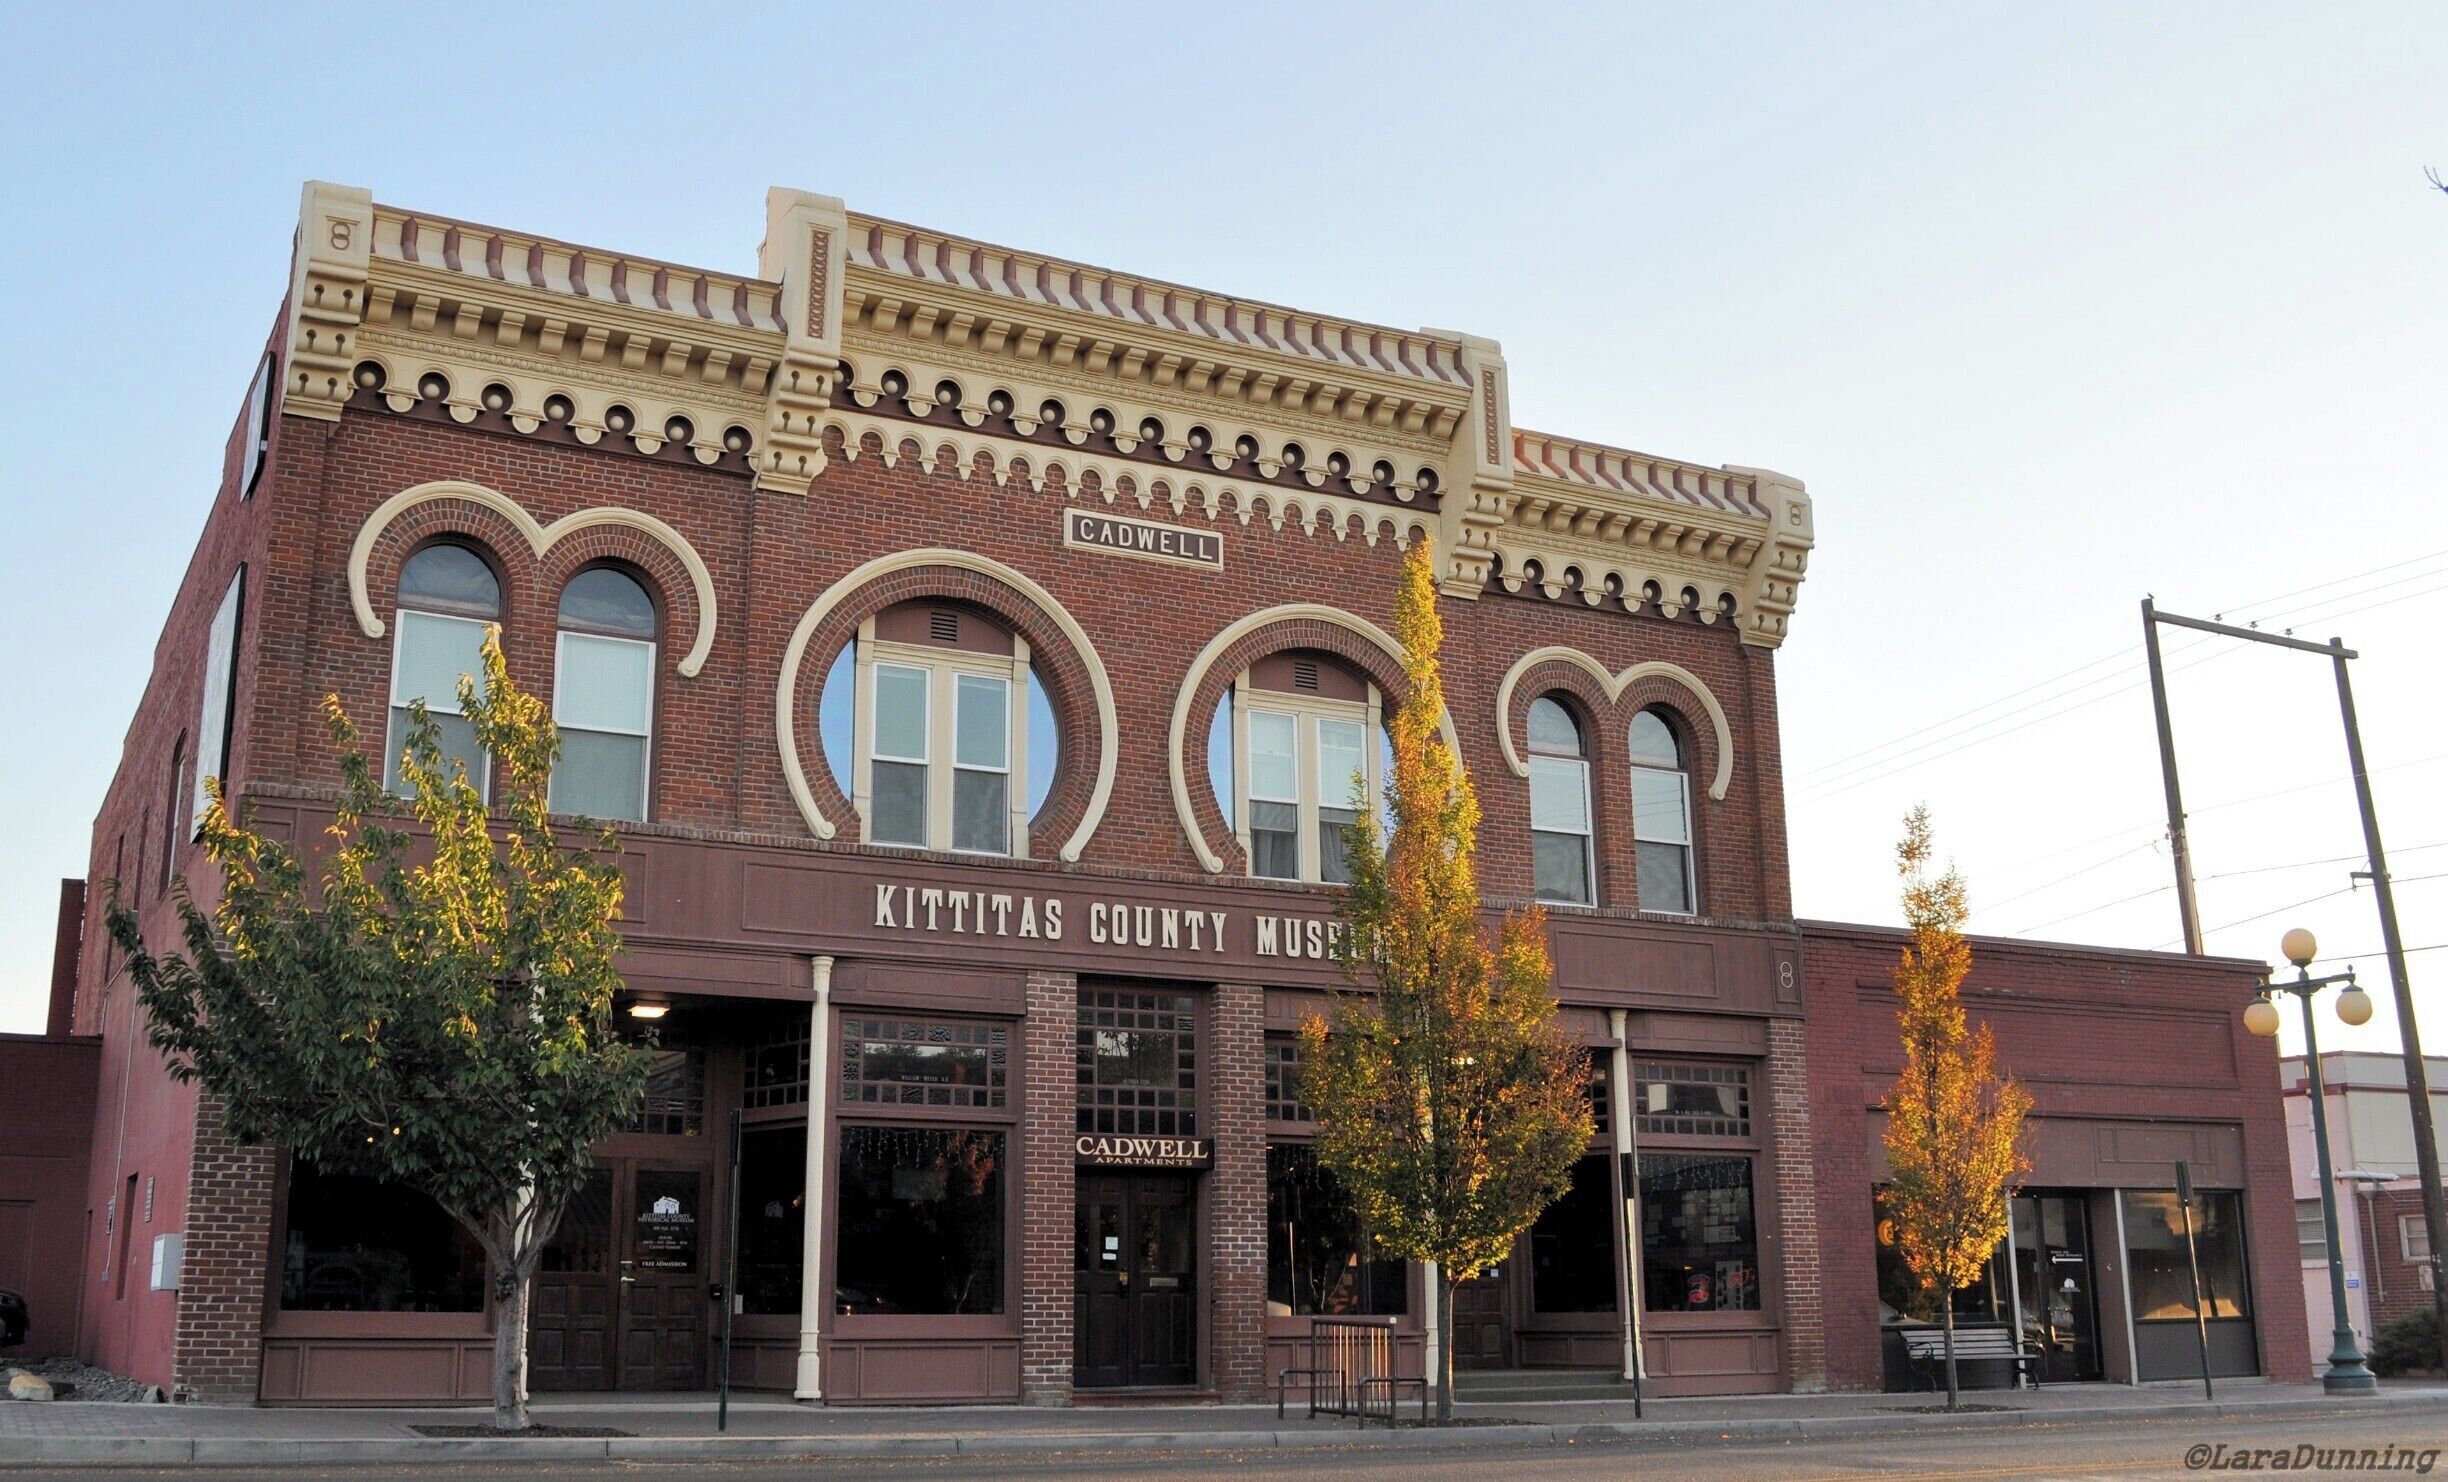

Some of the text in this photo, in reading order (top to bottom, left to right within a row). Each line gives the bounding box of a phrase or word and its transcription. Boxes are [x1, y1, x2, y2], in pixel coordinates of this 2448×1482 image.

[1080, 519, 1213, 560] CADWELL
[874, 884, 1062, 939] KITTITAS
[1090, 902, 1228, 952] COUNTY
[1076, 1136, 1208, 1159] CADWELL
[1094, 1157, 1193, 1166] APARTMENTS
